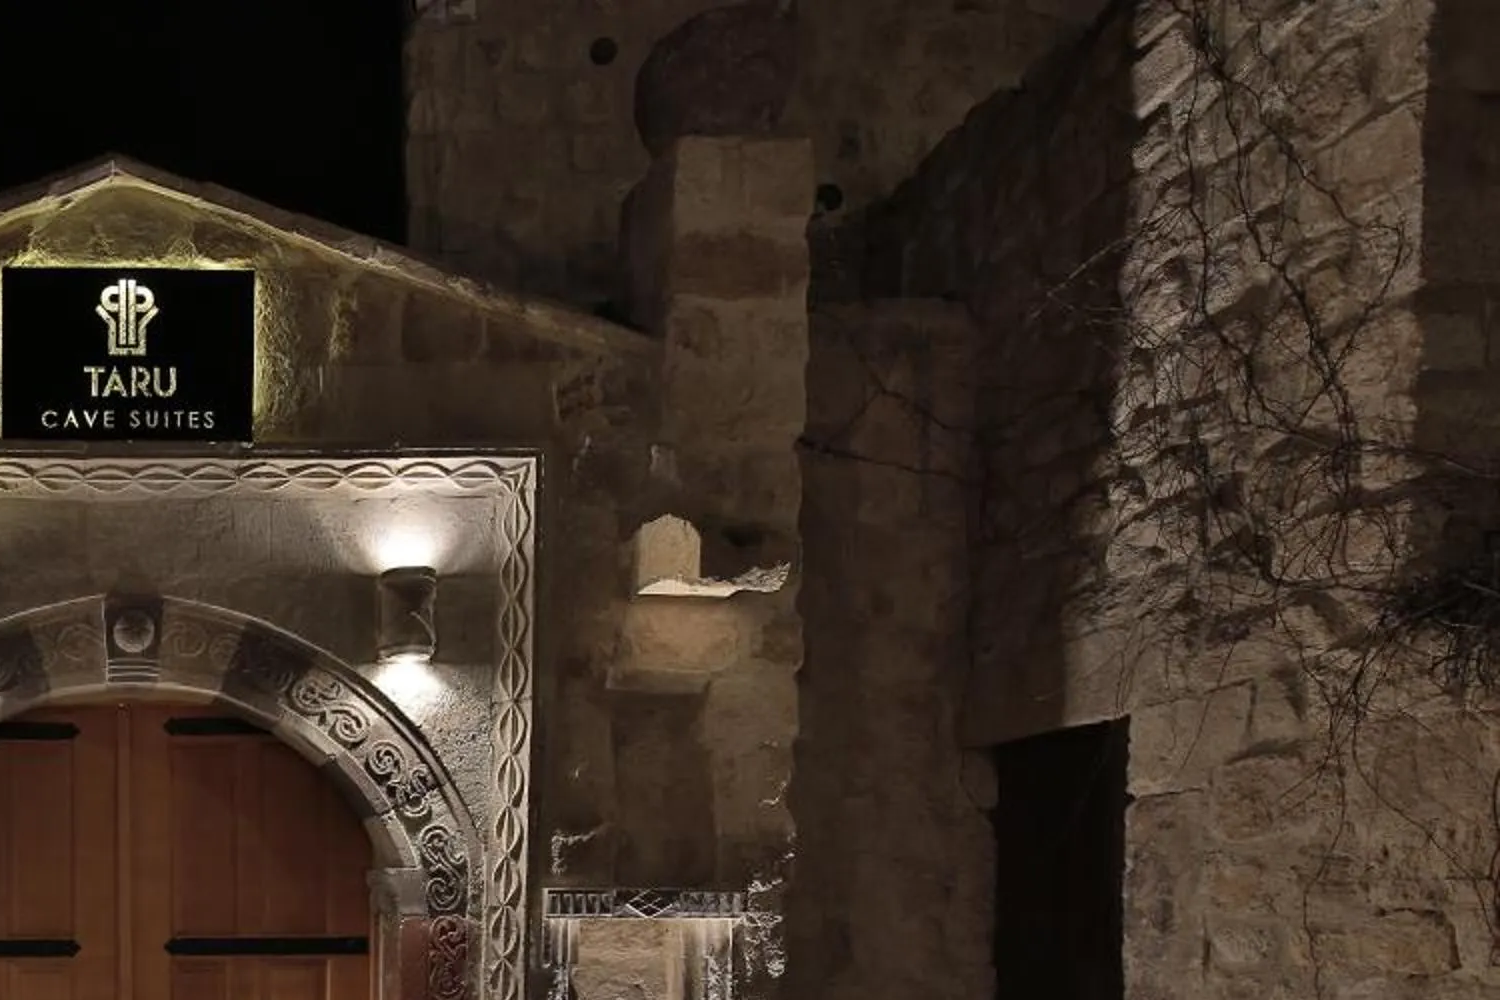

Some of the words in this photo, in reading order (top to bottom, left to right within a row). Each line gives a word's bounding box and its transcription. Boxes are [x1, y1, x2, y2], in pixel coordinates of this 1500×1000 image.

[84, 366, 177, 397] TARU
[41, 410, 115, 429] CAVE
[129, 410, 215, 429] SUITES
